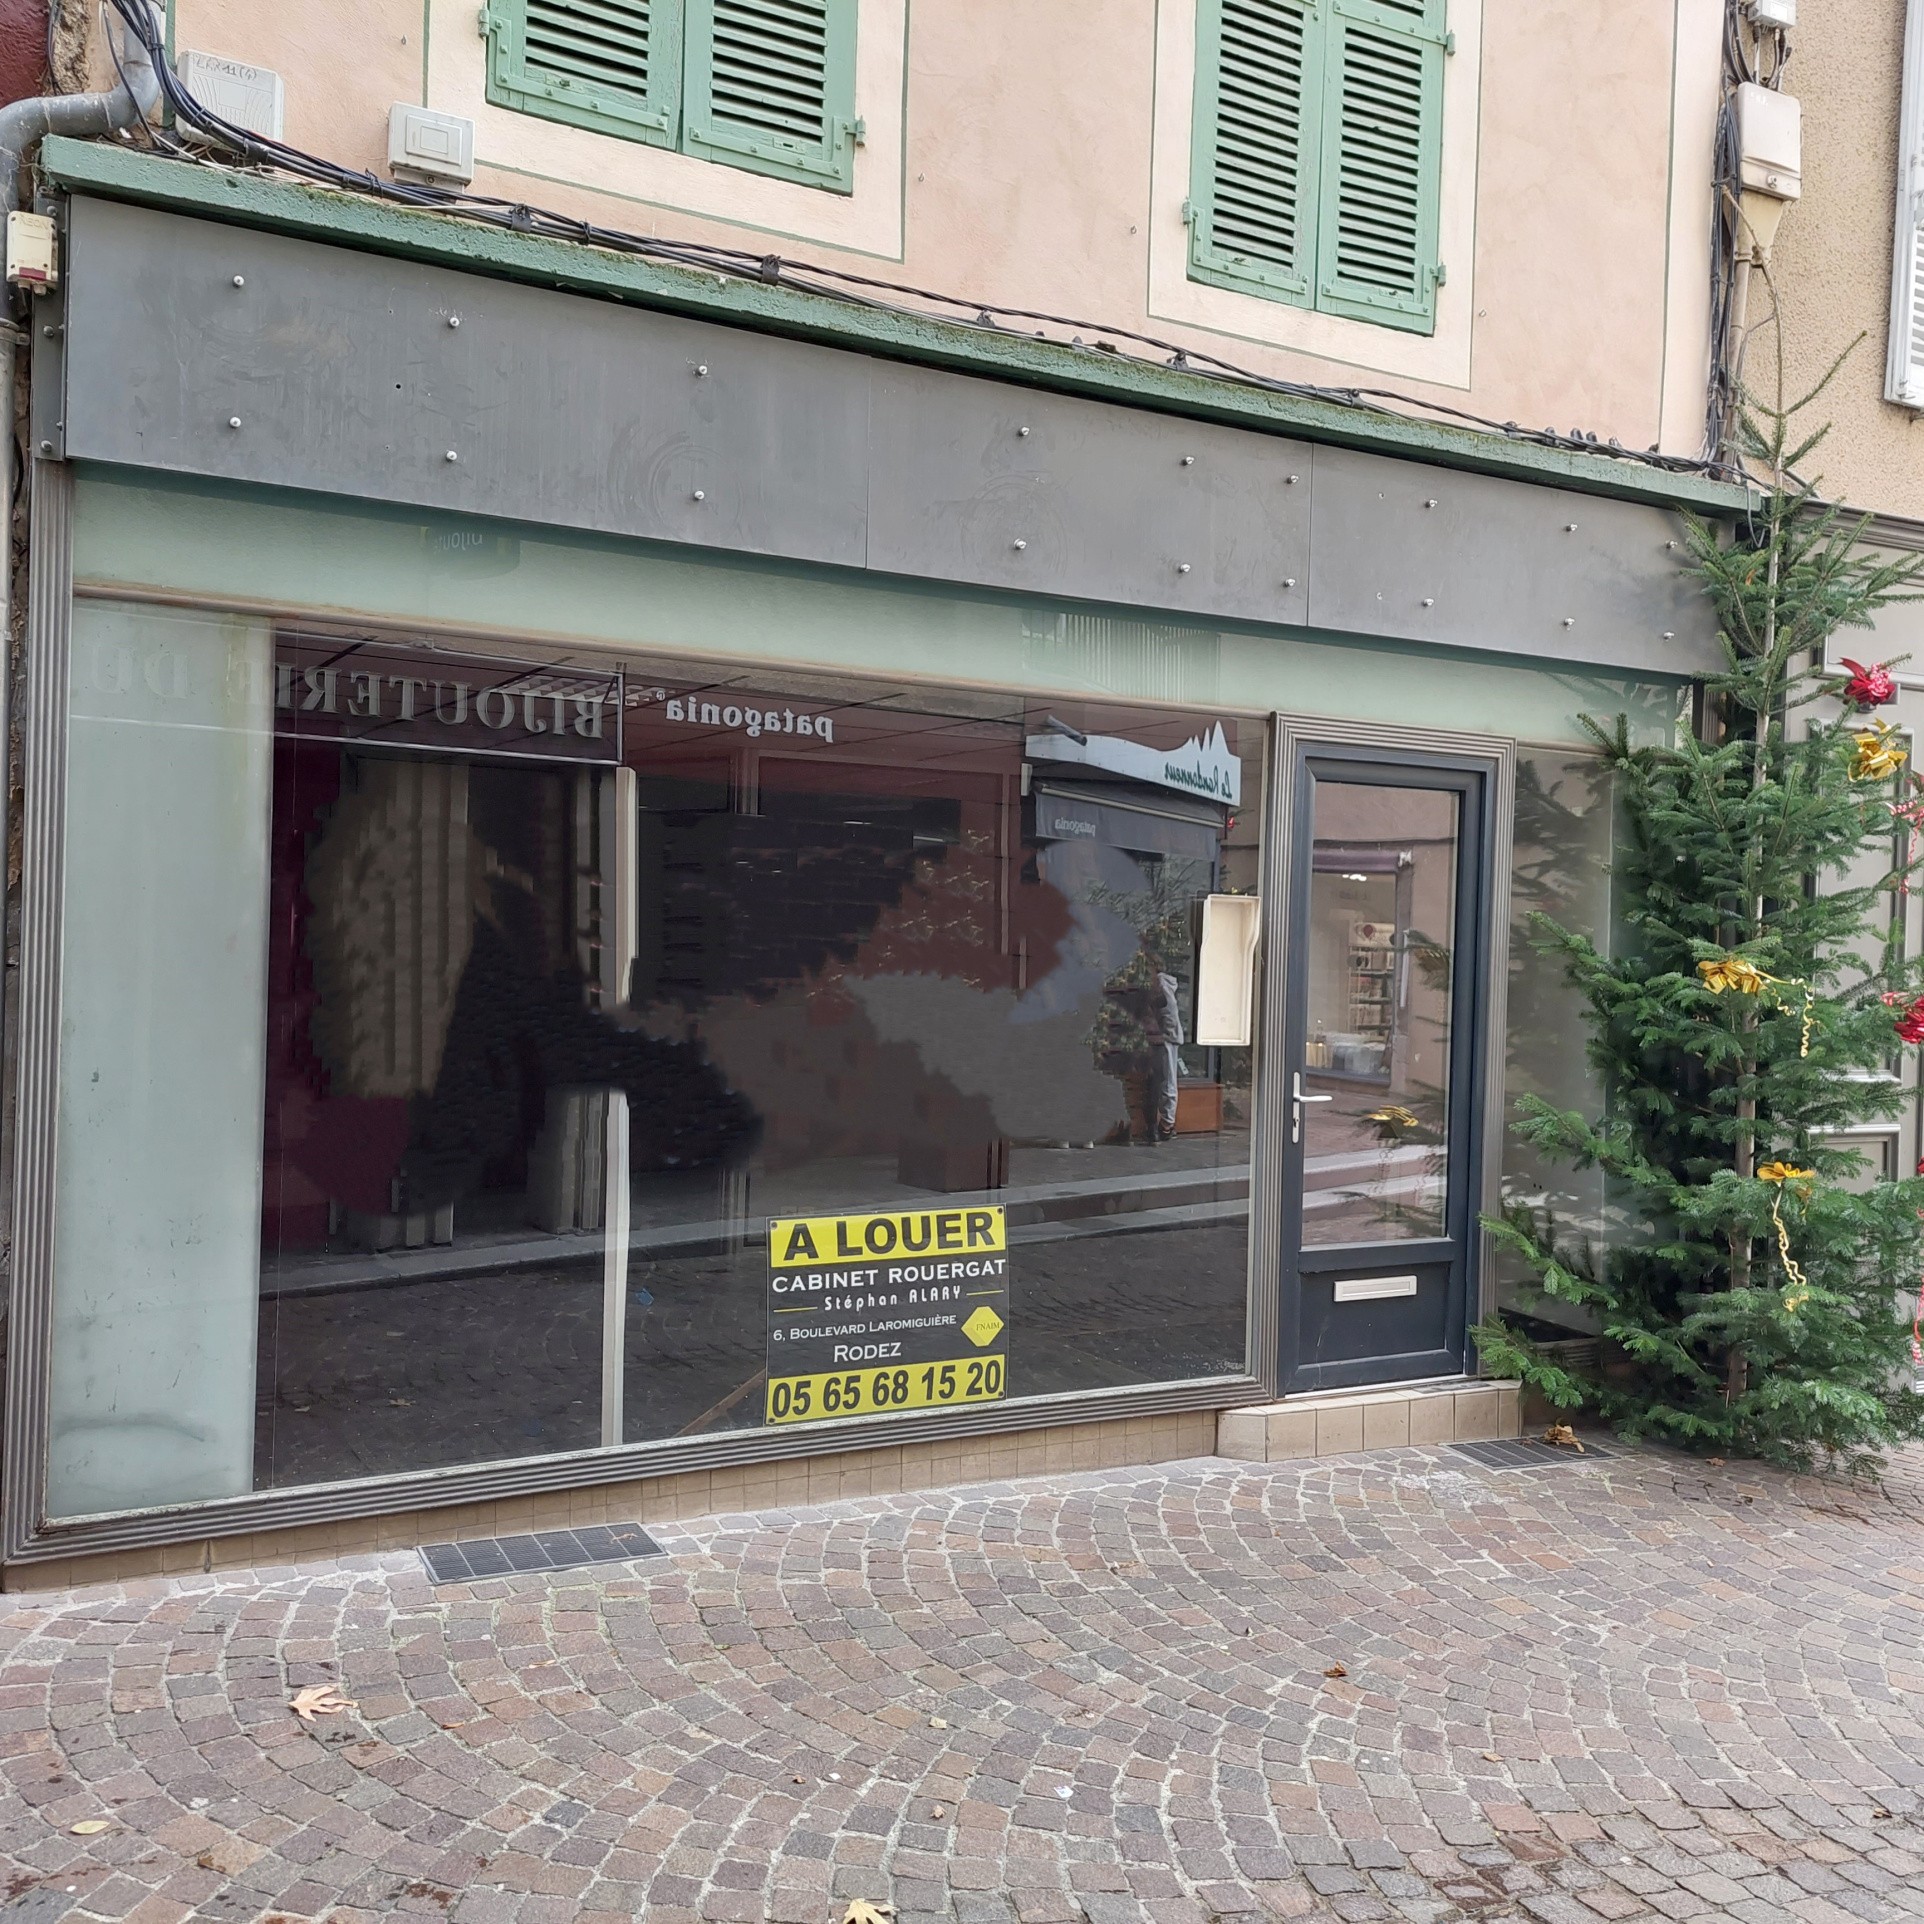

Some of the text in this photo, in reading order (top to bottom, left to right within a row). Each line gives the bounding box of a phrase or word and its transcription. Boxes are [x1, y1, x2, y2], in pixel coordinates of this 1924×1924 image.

[783, 1212, 995, 1261] A LOUER
[772, 1258, 1006, 1293] CABINET ROUERGAT
[824, 1285, 962, 1312] Stéphan ALARY
[790, 1323, 866, 1340] BOULEVARD
[869, 1314, 957, 1332] LAROMIGUIÈRE
[976, 1321, 1000, 1331] FNAIM
[833, 1342, 902, 1363] RODEZ
[772, 1360, 1000, 1418] 05 65 68 15 20
